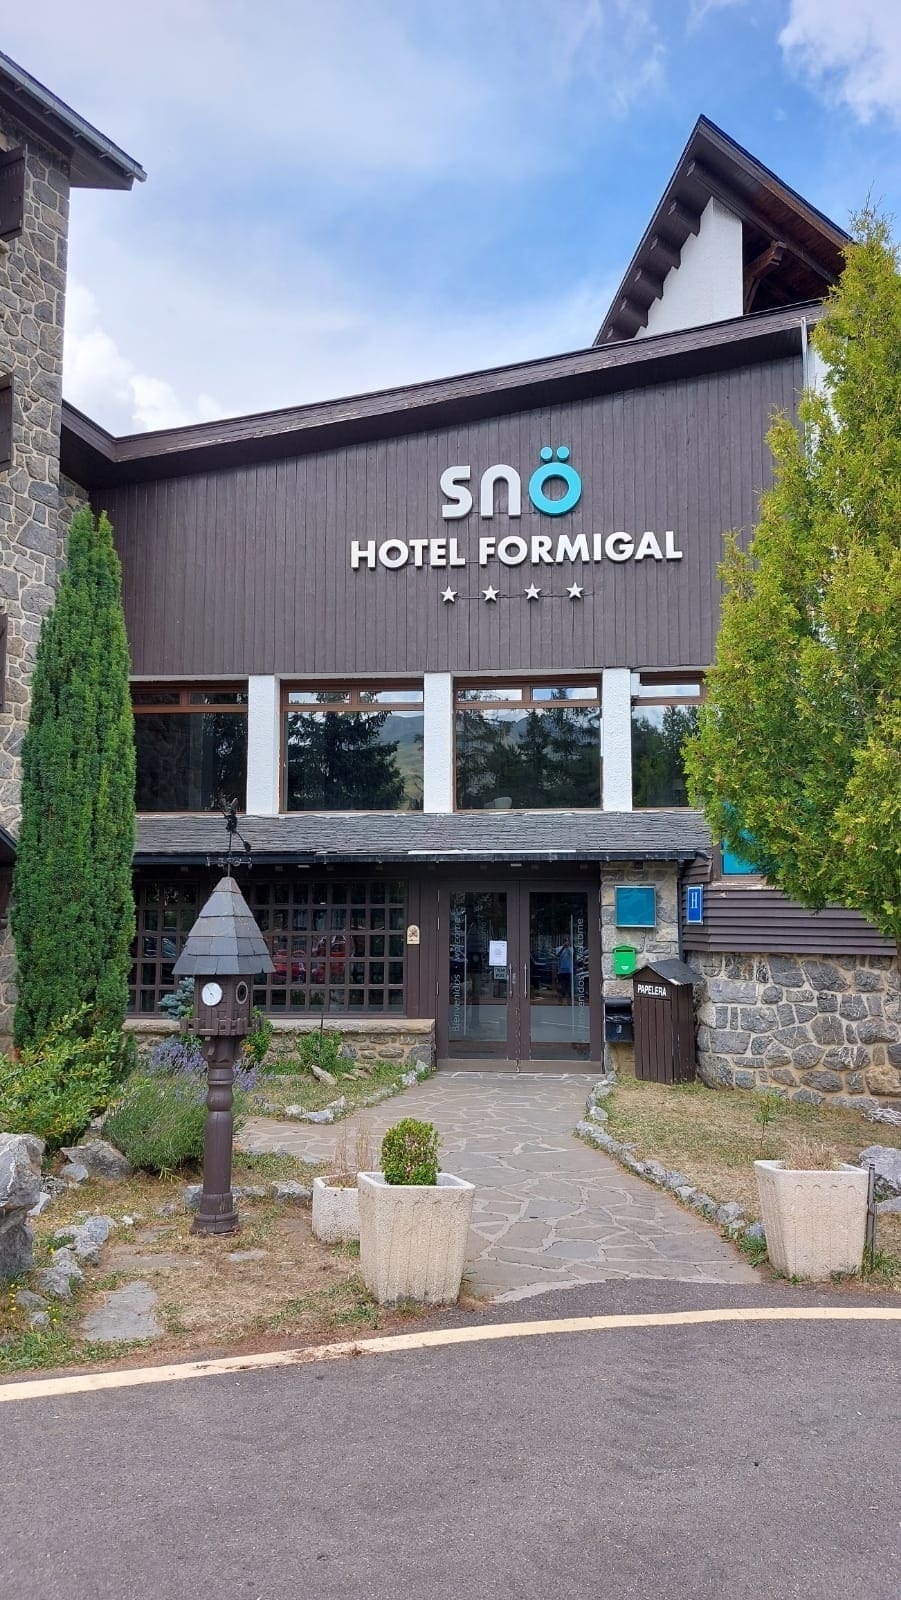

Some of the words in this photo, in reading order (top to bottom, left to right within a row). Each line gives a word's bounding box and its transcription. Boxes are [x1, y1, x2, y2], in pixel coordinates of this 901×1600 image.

[350, 537, 466, 570] HOTEL
[478, 530, 683, 566] FORMIGAL
[637, 983, 667, 997] PAPELERA
